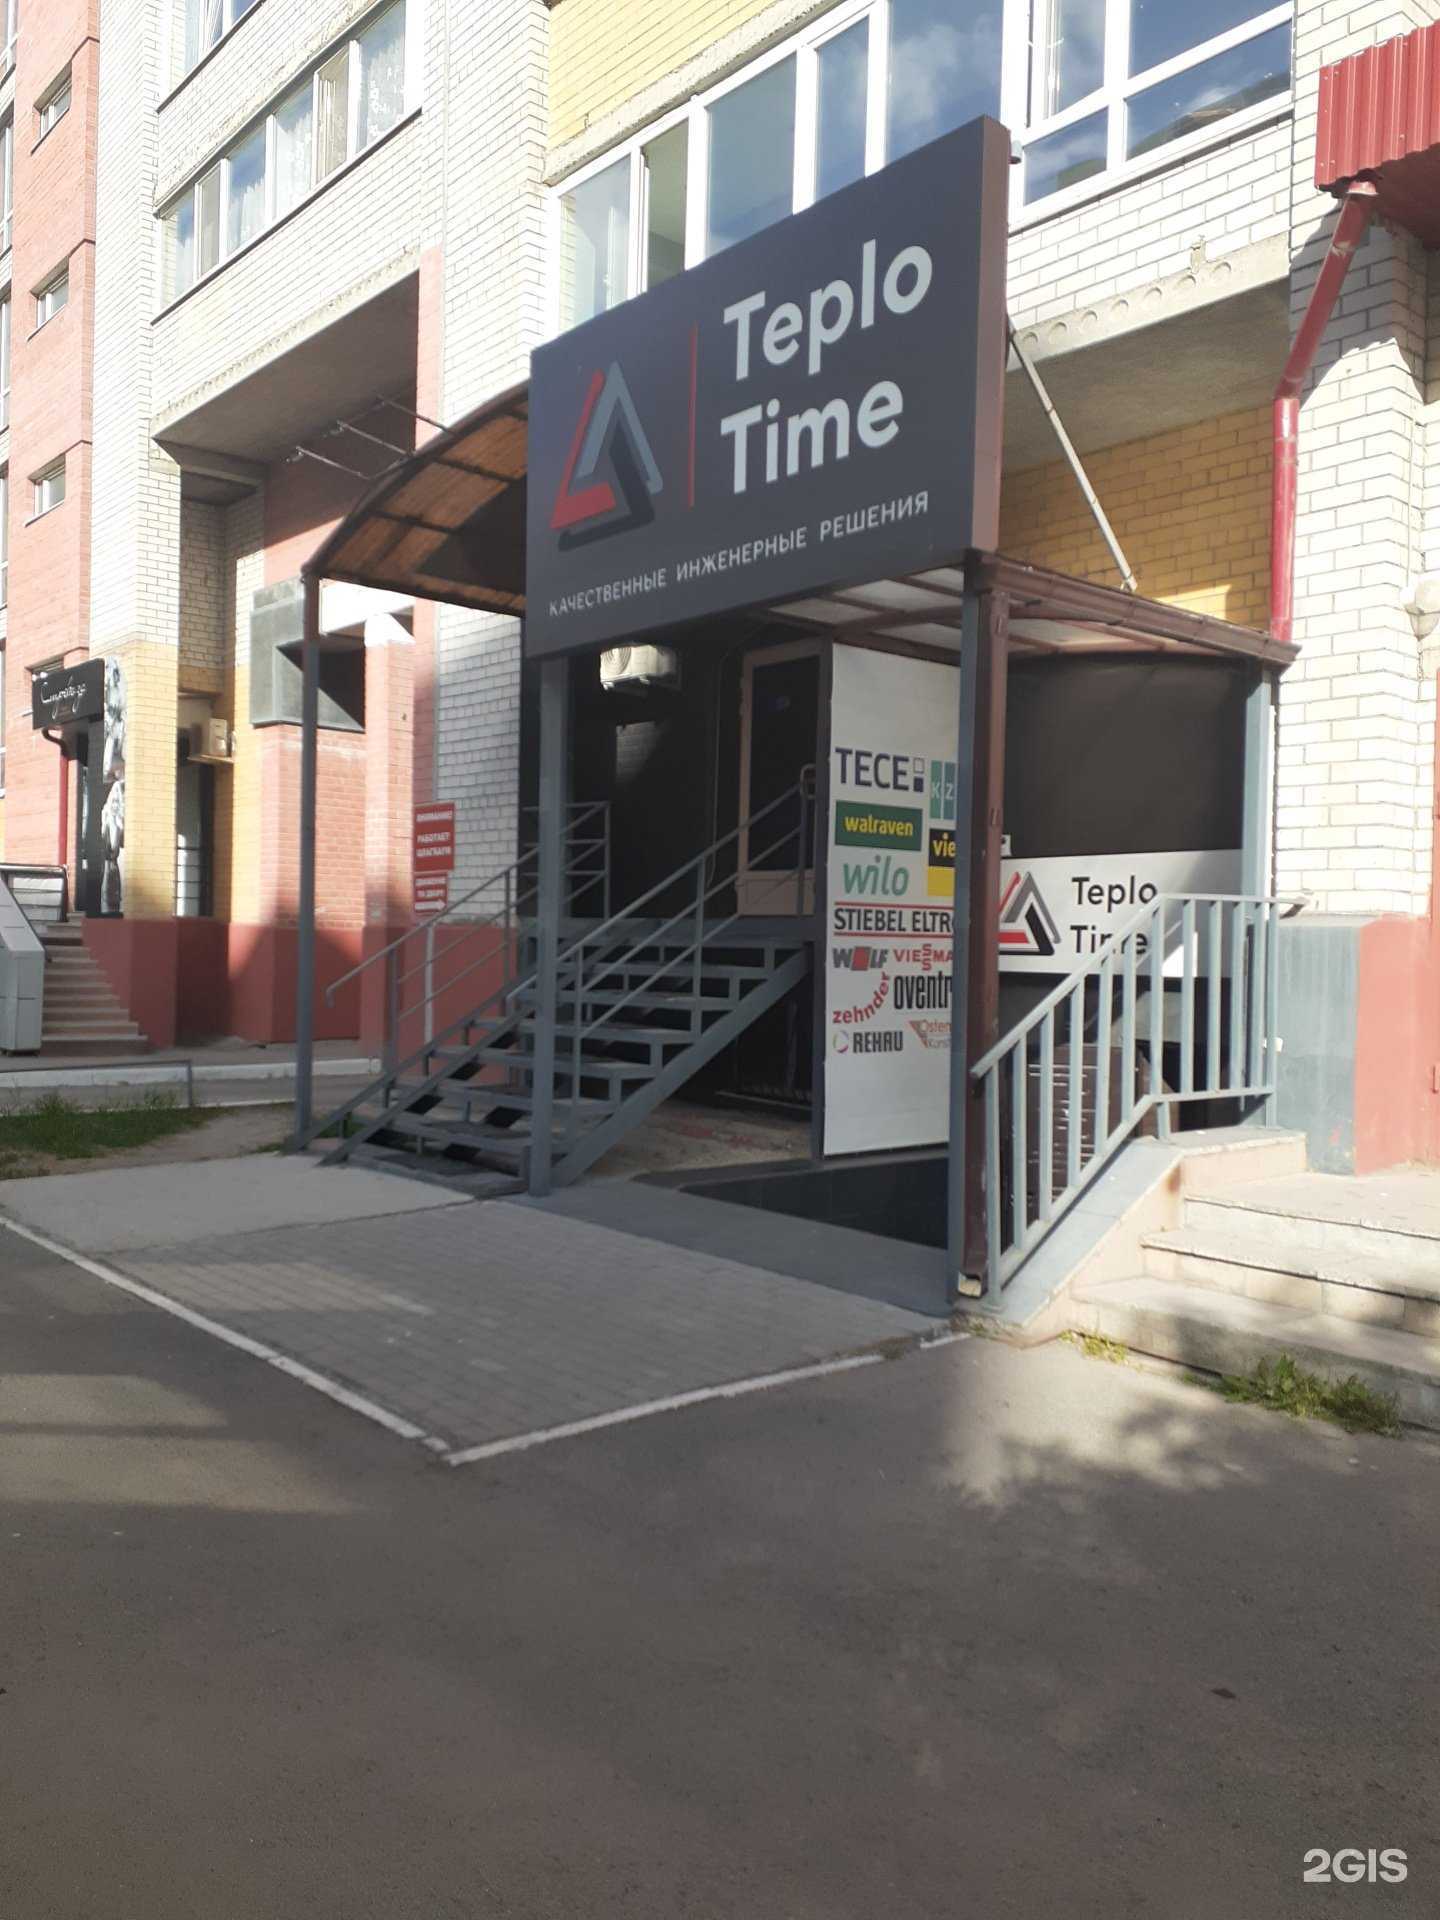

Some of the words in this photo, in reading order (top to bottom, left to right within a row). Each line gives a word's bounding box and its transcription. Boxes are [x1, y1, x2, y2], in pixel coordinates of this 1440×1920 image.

[723, 238, 933, 381] Teplo
[720, 380, 904, 494] Time
[549, 567, 667, 616] КАЧЕСТВЕННЫЕ
[676, 526, 807, 582] ИНЖЕНЕРНЫЕ
[819, 490, 929, 541] РЕШЕНИЯ
[835, 747, 910, 791] TECE
[844, 814, 914, 837] walraven
[843, 854, 909, 896] wilo
[1071, 875, 1158, 913] Teplo
[834, 908, 906, 932] STIEBEL
[912, 911, 954, 933] ELTR
[832, 971, 891, 1024] zehnder
[853, 1031, 904, 1053] REHAU
